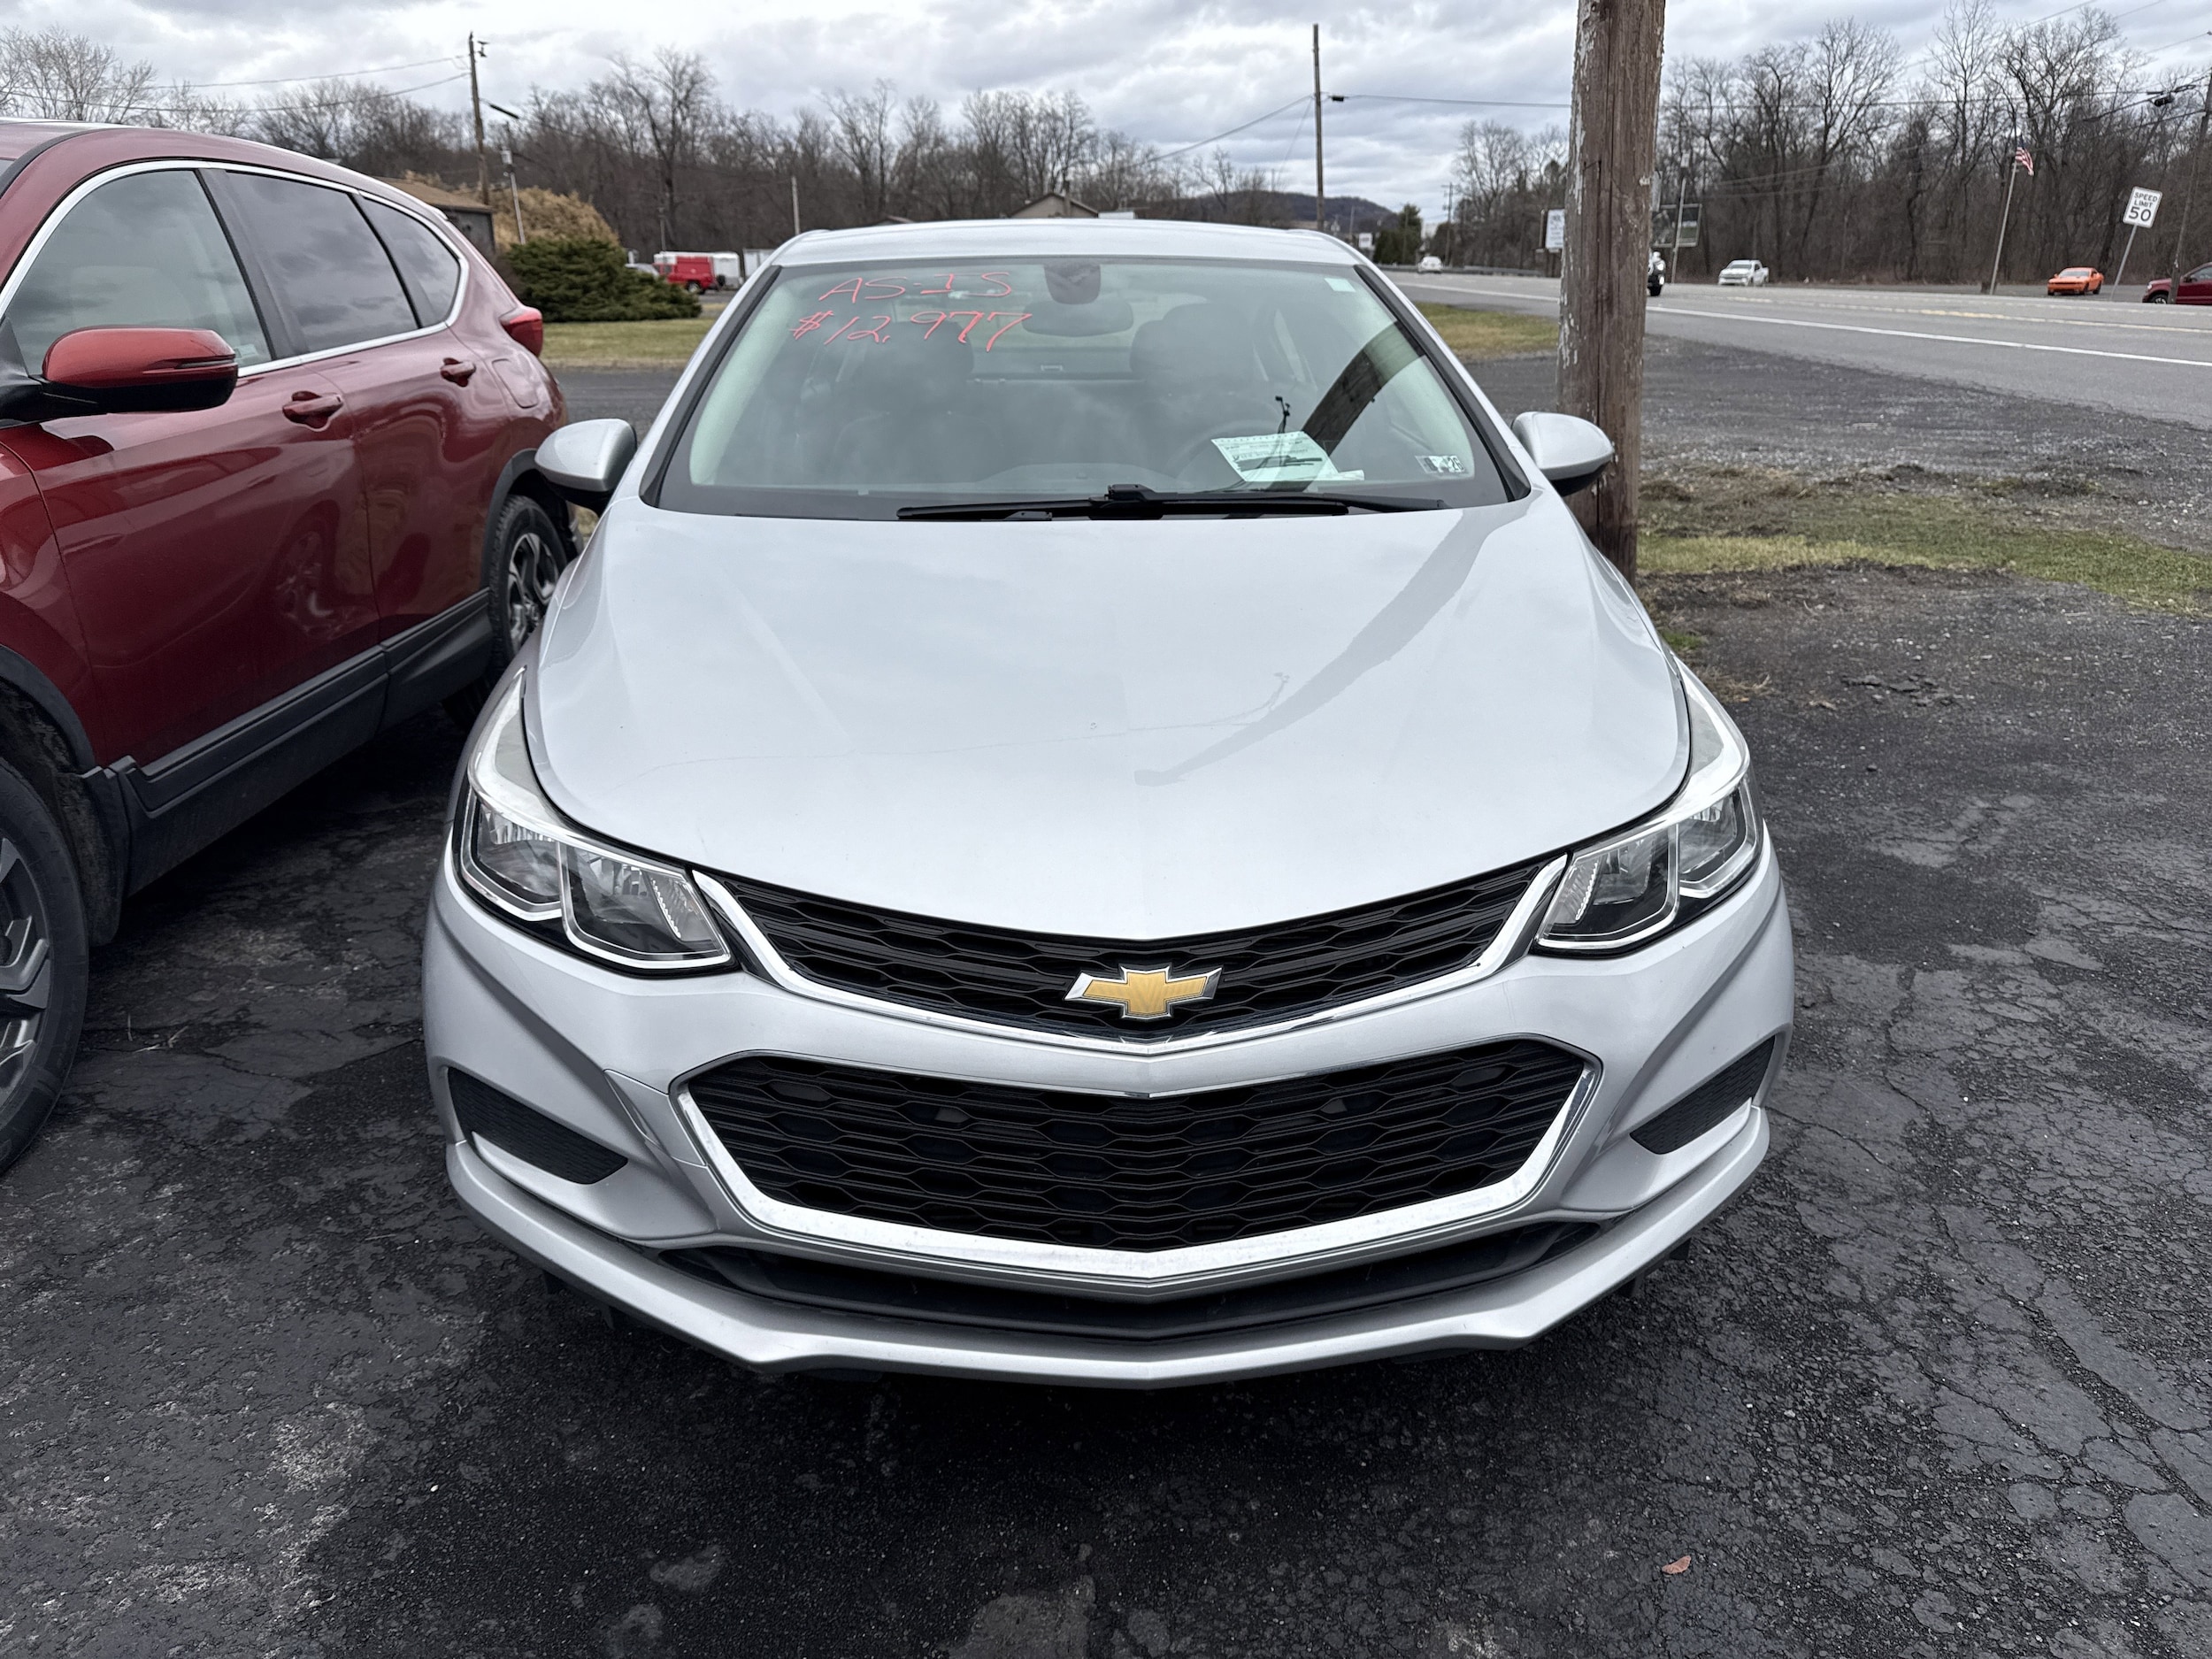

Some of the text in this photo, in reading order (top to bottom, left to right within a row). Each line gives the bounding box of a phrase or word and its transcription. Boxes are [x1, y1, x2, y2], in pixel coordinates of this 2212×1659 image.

[2134, 192, 2157, 202] SPEED
[2133, 199, 2153, 208] LIMIT
[2128, 206, 2151, 221] 50
